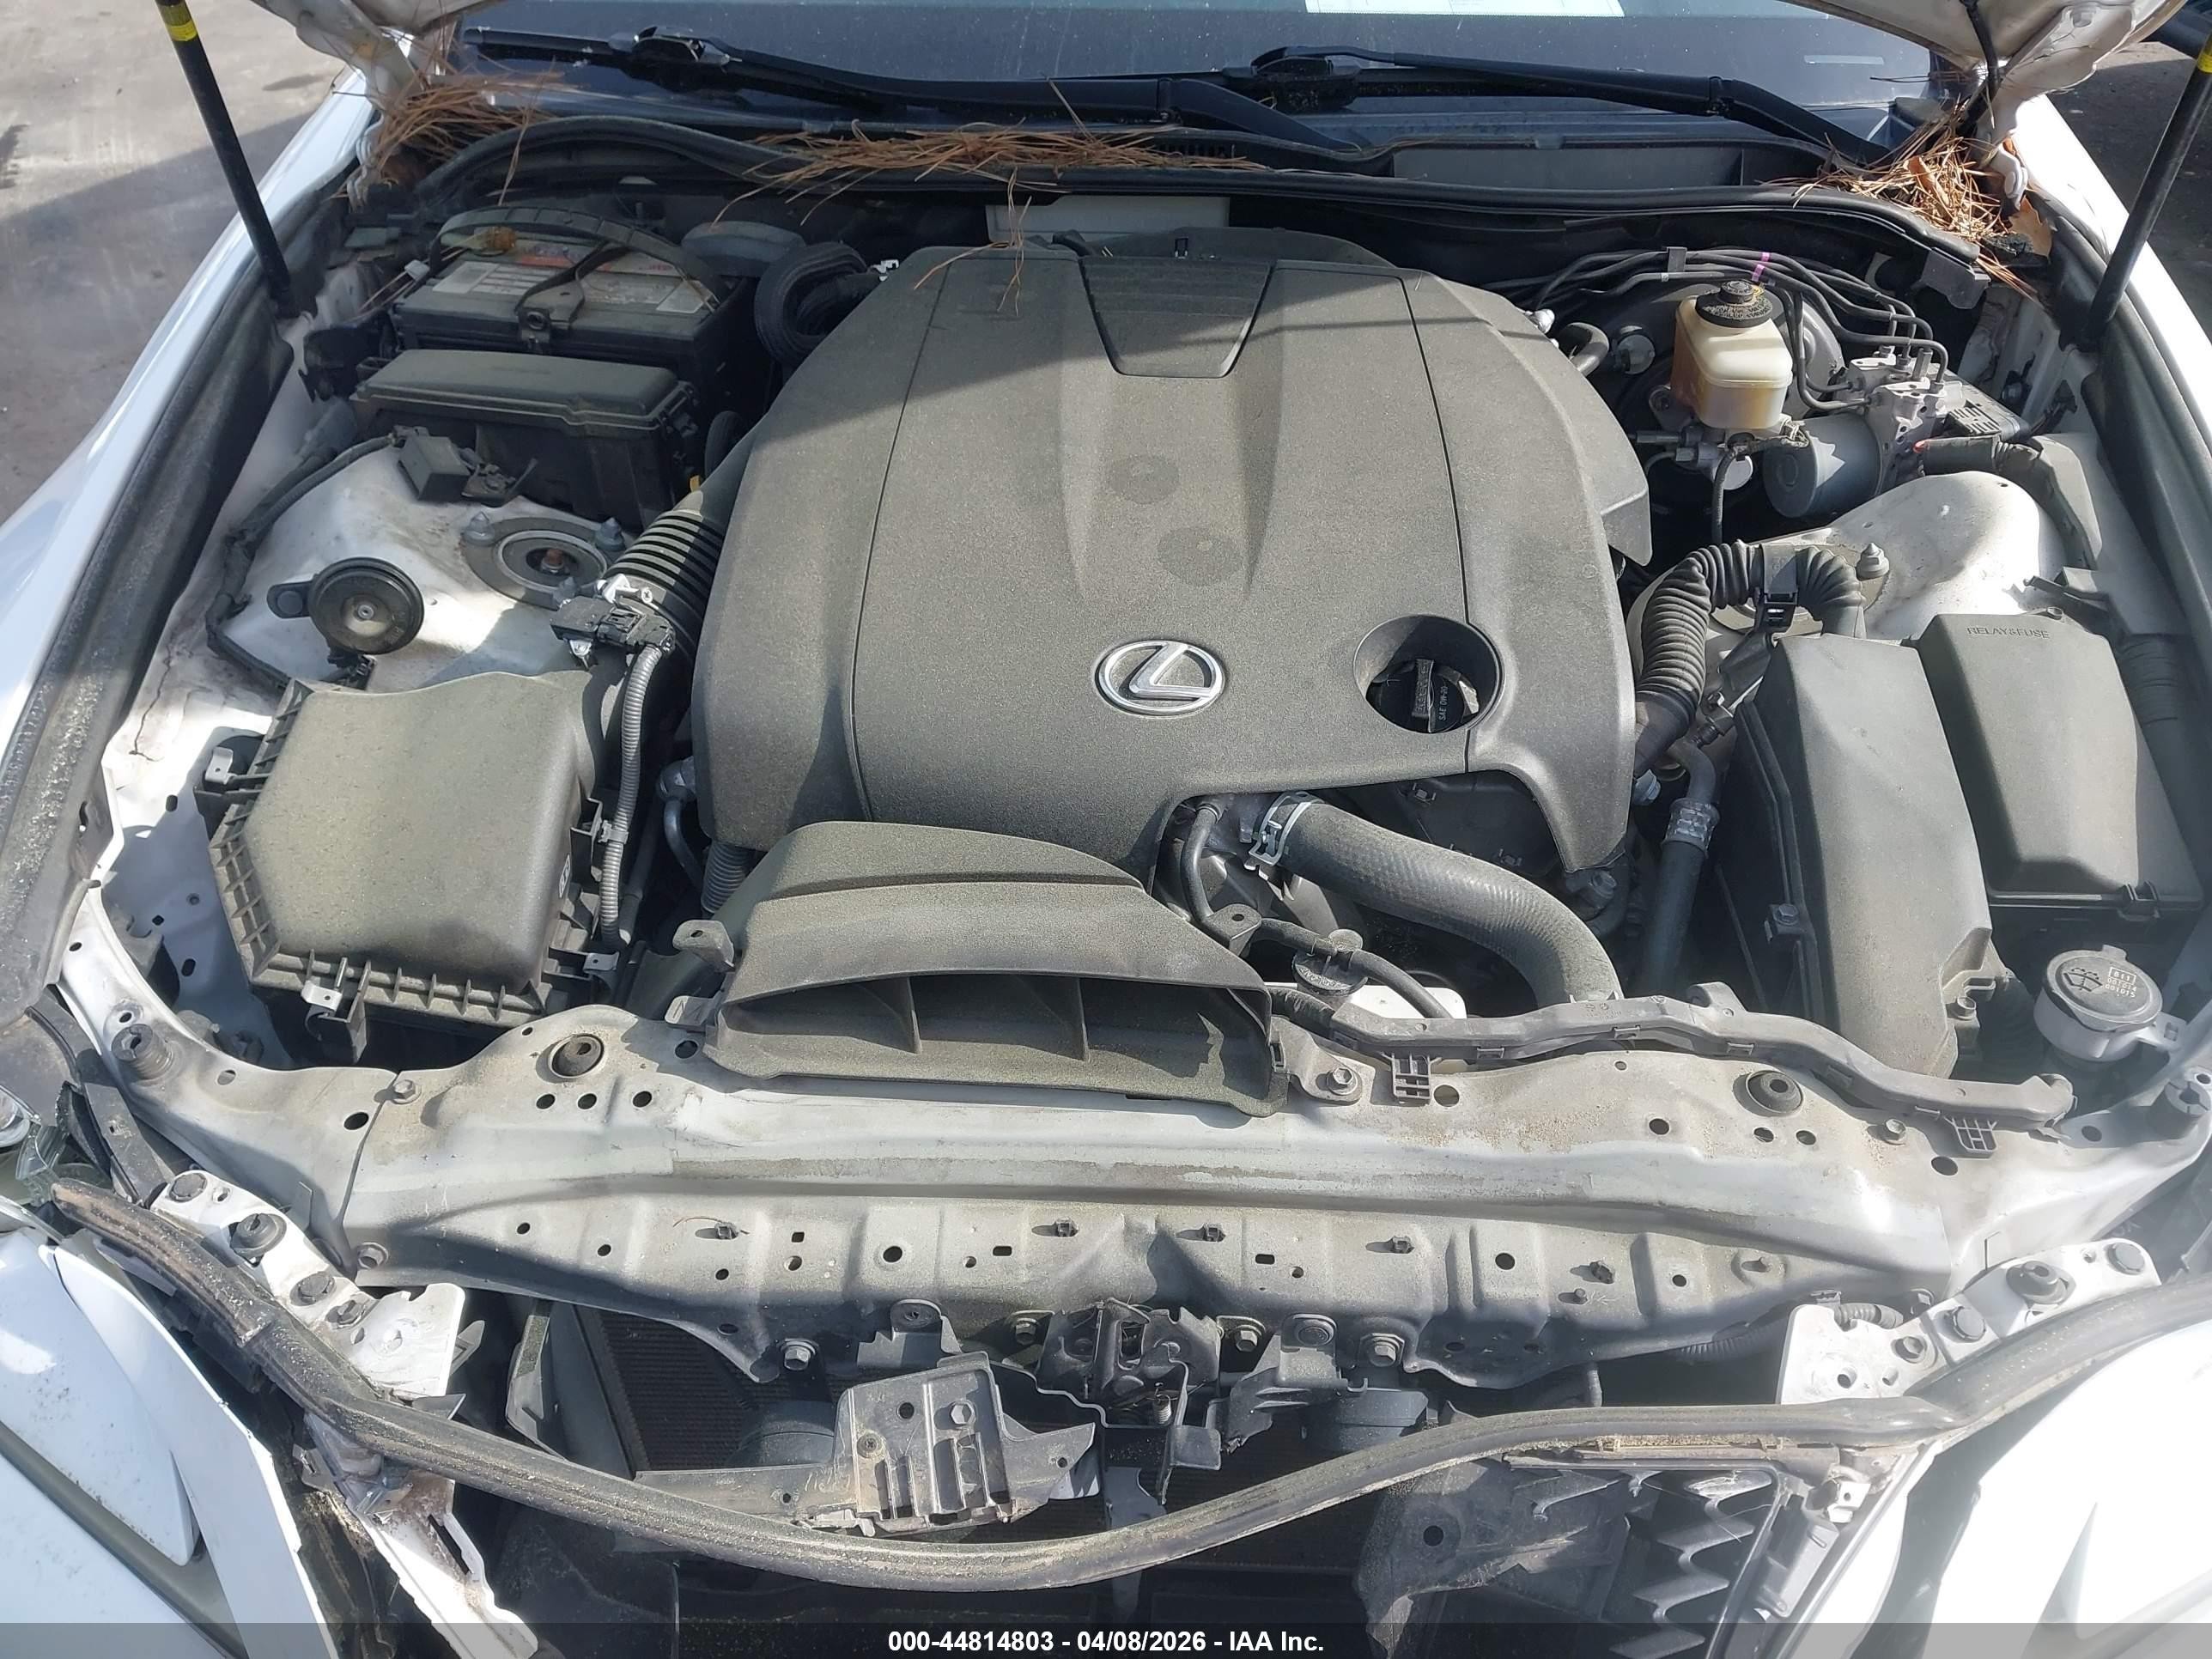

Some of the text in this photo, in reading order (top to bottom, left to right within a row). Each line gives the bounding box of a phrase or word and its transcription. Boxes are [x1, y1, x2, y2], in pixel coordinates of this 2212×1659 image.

[1966, 627, 2051, 639] RELAY&FUSE
[1438, 686, 1449, 720] SAE 0W-20
